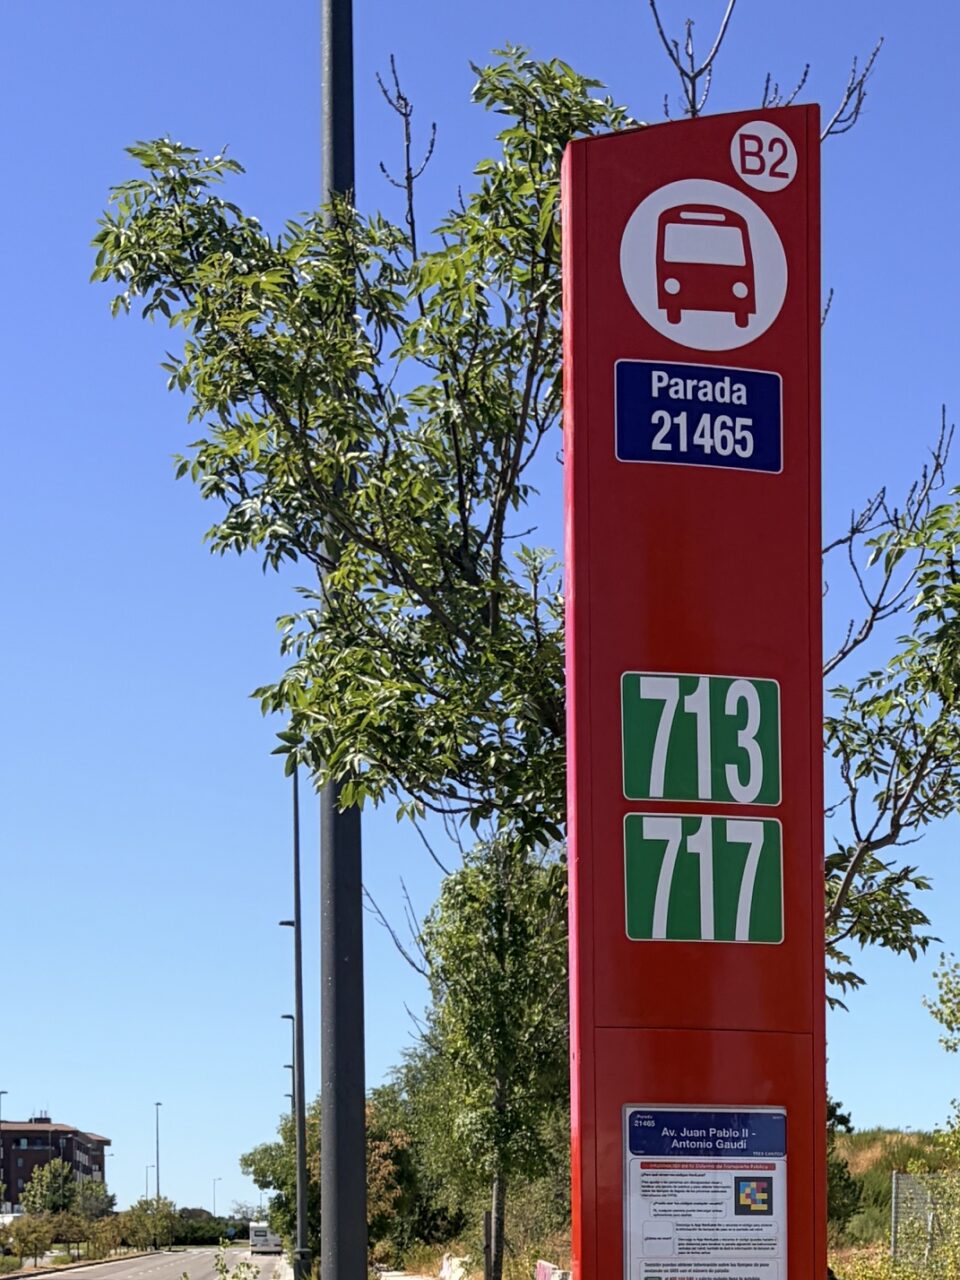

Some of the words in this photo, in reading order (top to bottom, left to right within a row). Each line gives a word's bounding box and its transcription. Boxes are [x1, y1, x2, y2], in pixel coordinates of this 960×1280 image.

[739, 133, 789, 179] B2
[651, 370, 747, 405] Parada
[651, 410, 754, 458] 21465
[639, 675, 763, 804] 713
[642, 816, 764, 941] 717
[661, 1127, 677, 1137] Av.
[680, 1128, 706, 1137] Juan
[709, 1128, 739, 1138] Pablo
[671, 1139, 713, 1149] Antonio
